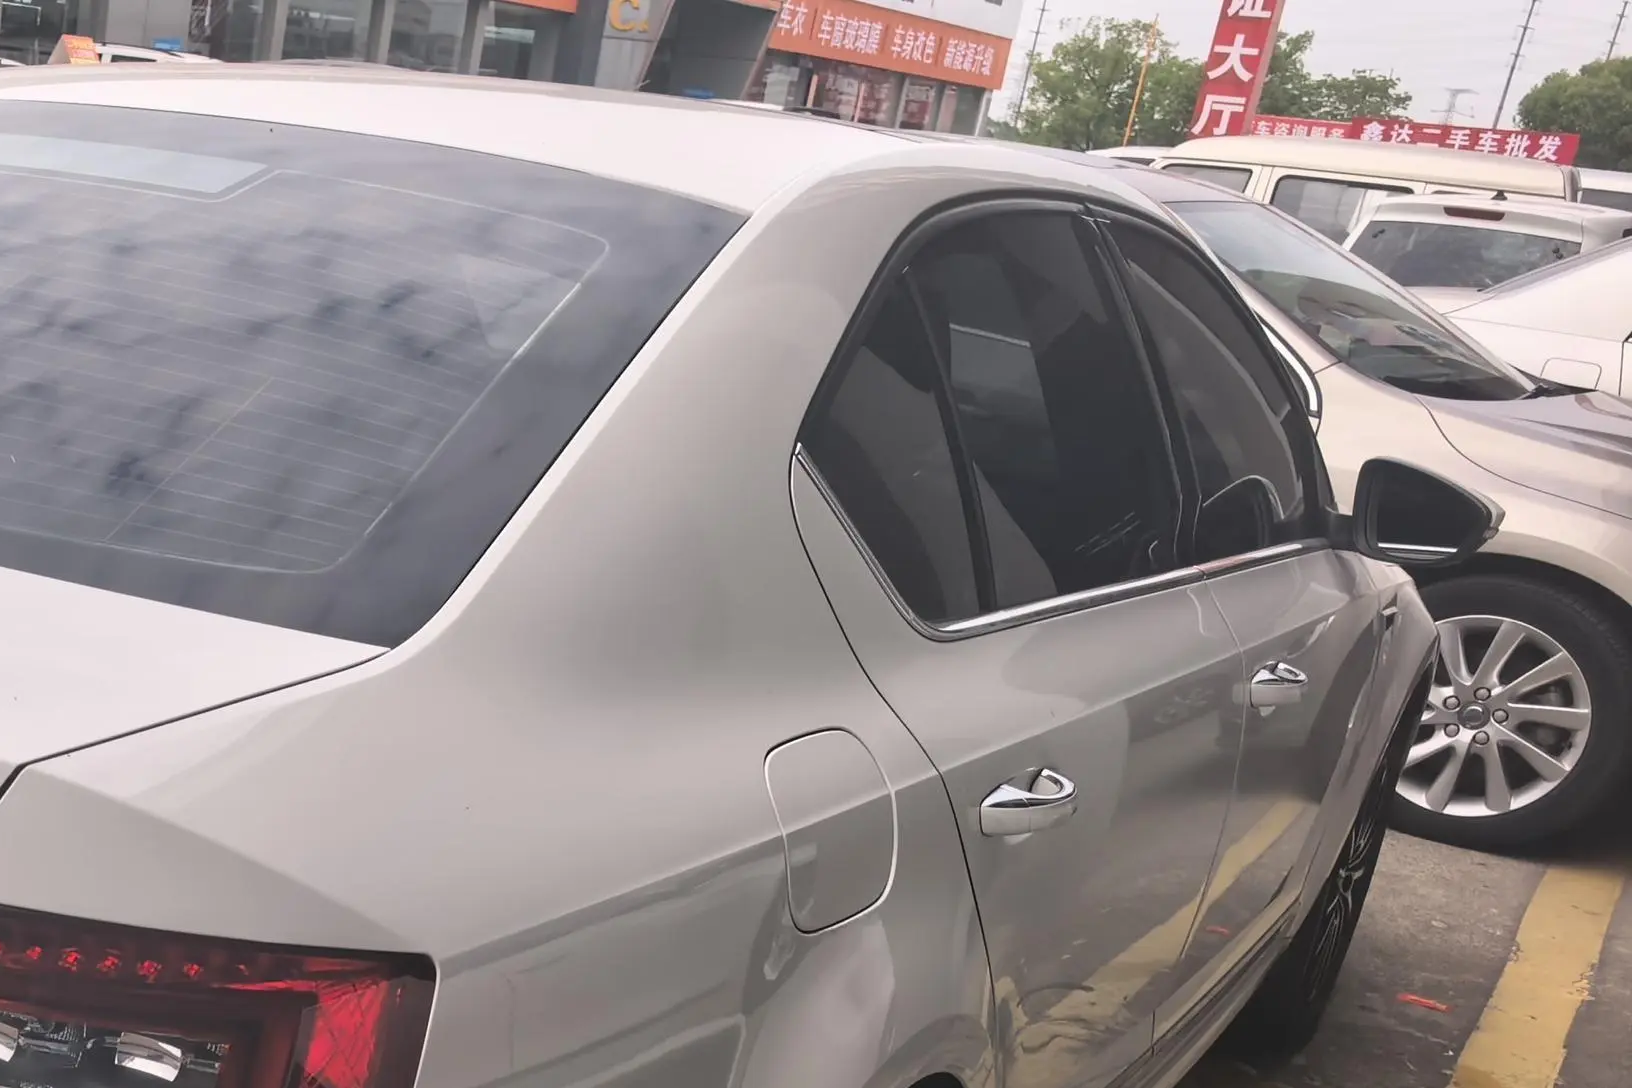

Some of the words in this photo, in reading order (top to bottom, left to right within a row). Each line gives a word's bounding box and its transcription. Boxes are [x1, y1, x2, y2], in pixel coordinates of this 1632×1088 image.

[777, 0, 808, 36] 车衣
[818, 9, 883, 54] 车窗玻璃膜
[891, 24, 936, 64] 车身改色
[944, 38, 995, 76] 新能源升级
[1252, 120, 1345, 138] 车咨询服务
[1360, 121, 1562, 161] 鑫达二手车批发
